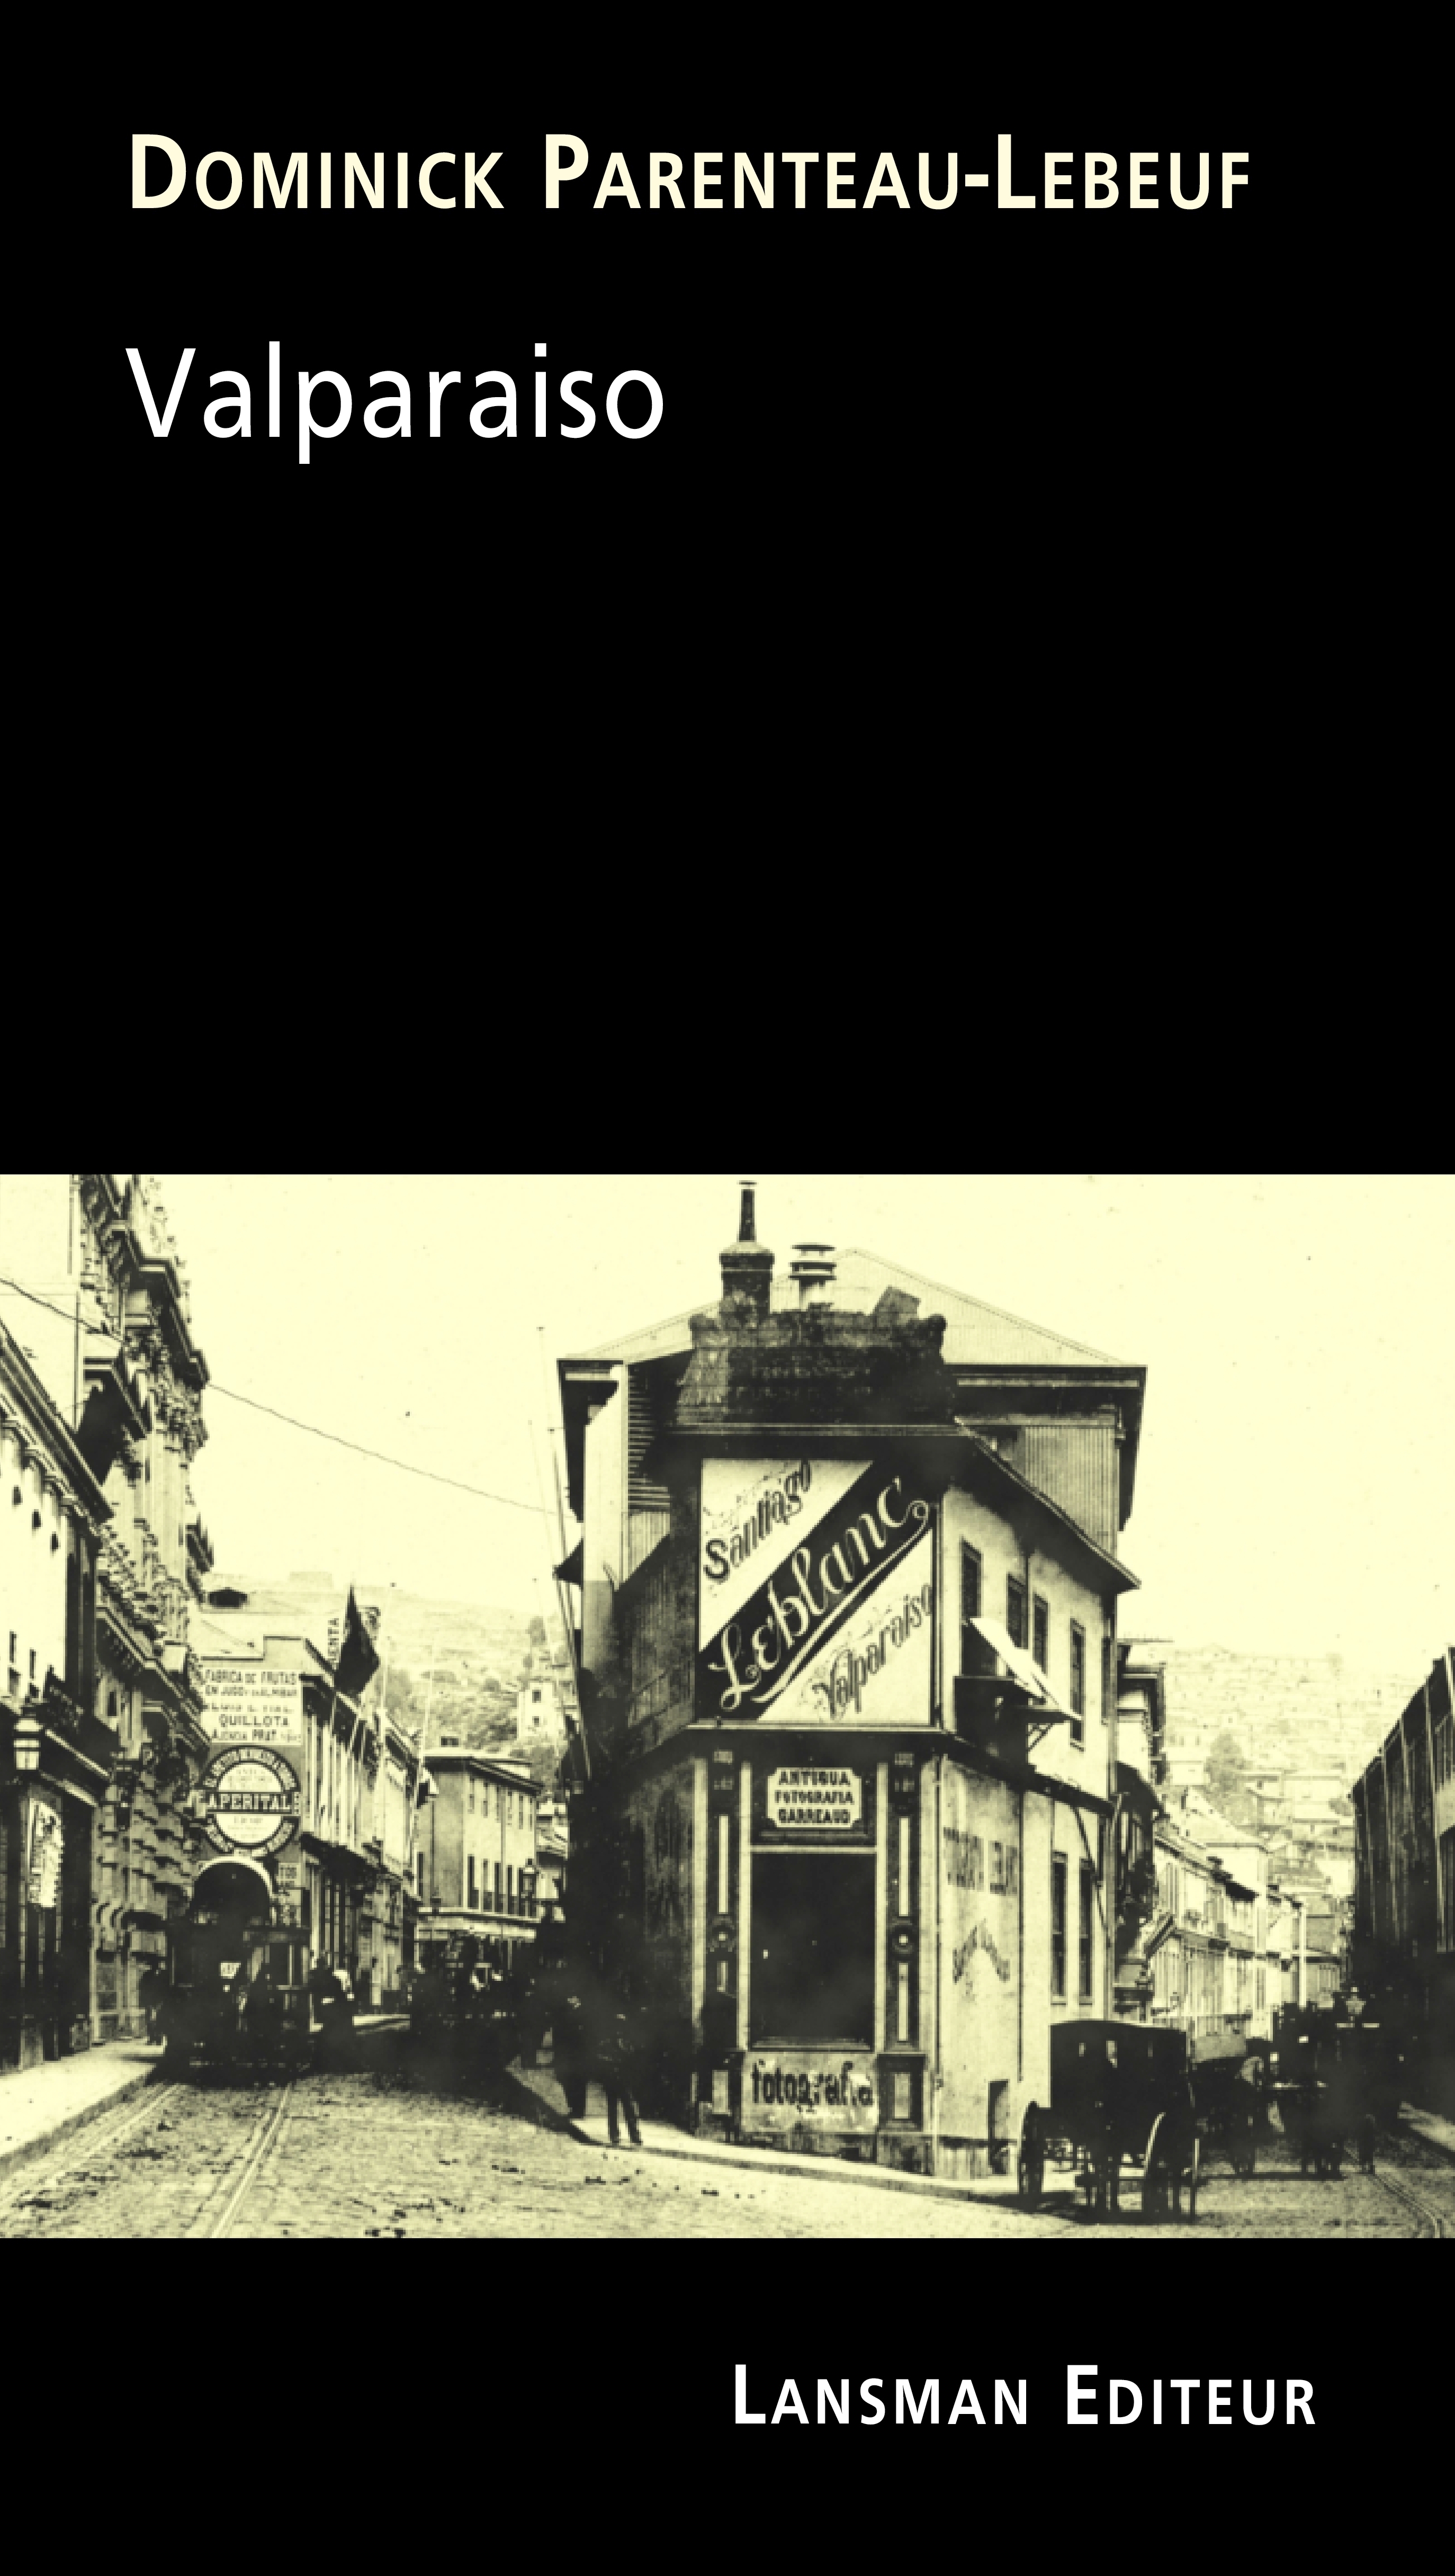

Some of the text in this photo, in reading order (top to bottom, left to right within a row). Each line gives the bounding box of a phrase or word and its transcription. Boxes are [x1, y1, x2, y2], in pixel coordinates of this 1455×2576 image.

[703, 1461, 812, 1583] Santiago
[707, 1475, 930, 1712] Leblanc
[812, 1583, 933, 1720] Valparaiso
[219, 1714, 289, 1727] QUILLOTA
[778, 1770, 851, 1786] ANTIGUA
[207, 1793, 291, 1810] APERITAL
[775, 1790, 854, 1804] FOTOGRAFIA
